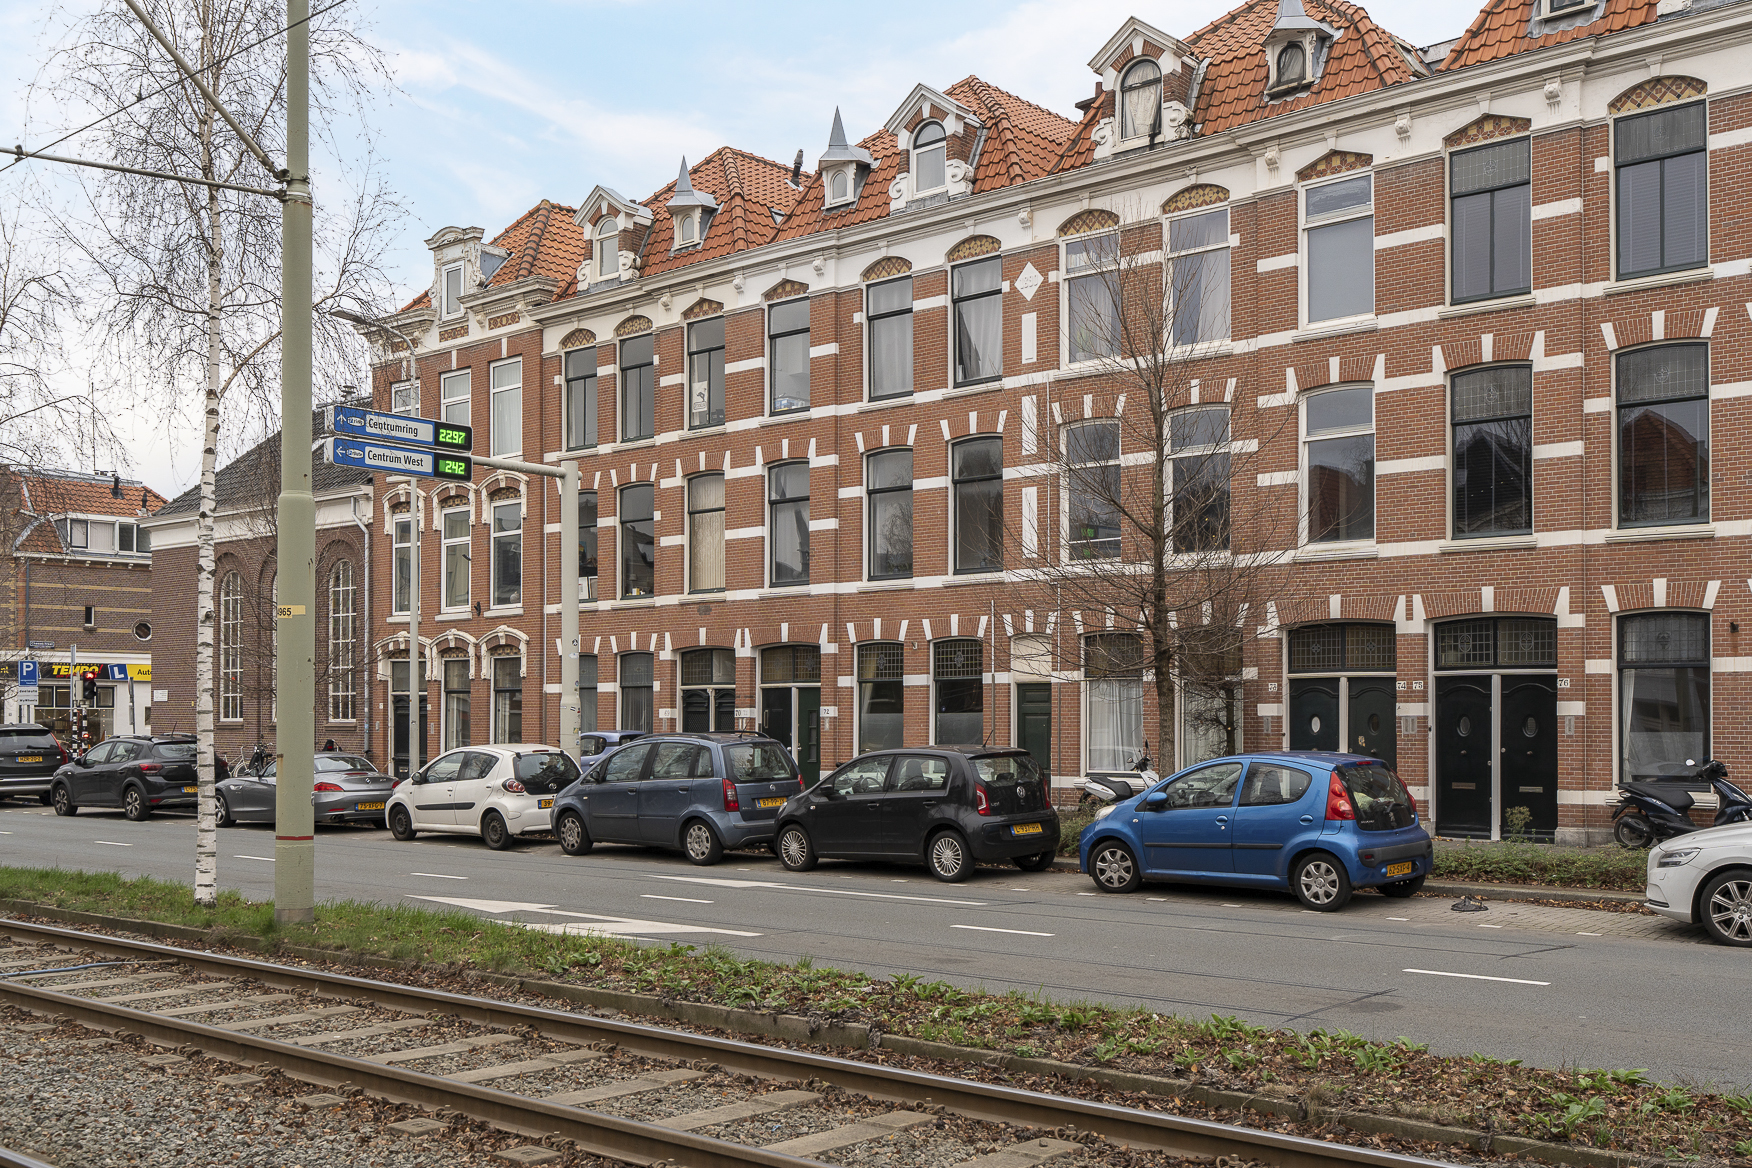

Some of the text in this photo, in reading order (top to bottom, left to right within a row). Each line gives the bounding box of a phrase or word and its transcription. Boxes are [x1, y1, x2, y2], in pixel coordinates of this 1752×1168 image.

[368, 418, 418, 437] Centrumring
[439, 428, 466, 444] 2297
[367, 449, 424, 467] Centrum West
[445, 460, 465, 475] 242
[277, 607, 292, 616] 965
[23, 662, 34, 676] P
[113, 666, 124, 678] L
[1397, 681, 1406, 690] 74
[1413, 681, 1423, 689] 75
[1558, 679, 1569, 687] 76
[1388, 863, 1410, 875] 62-SXF-4
